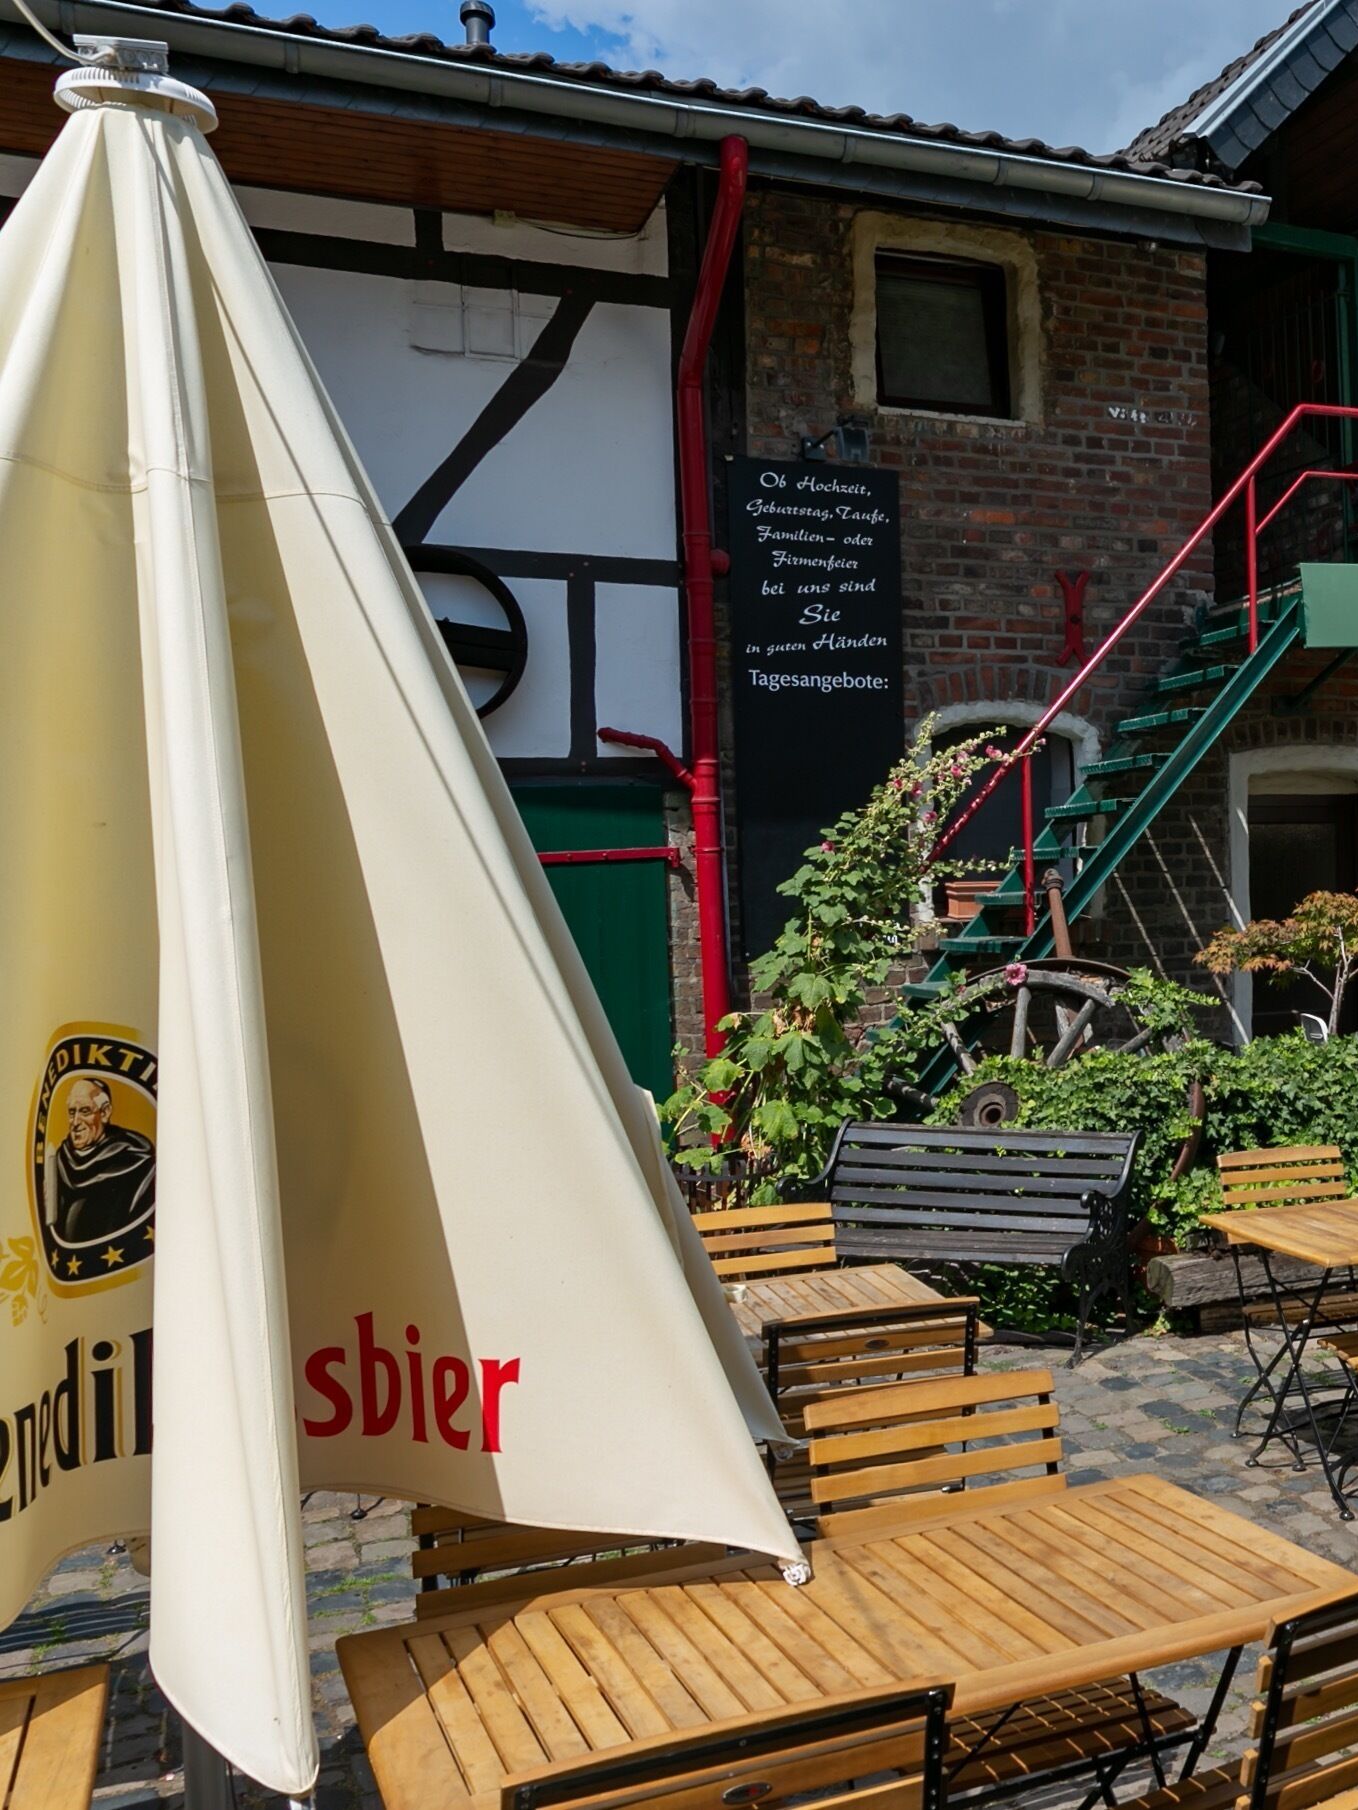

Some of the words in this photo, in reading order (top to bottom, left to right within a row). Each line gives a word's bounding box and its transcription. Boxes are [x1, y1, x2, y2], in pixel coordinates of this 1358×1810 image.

[760, 472, 787, 488] Ob
[797, 476, 872, 496] Hochzeit,
[746, 499, 833, 521] Geburtstag,
[836, 506, 890, 524] Taufe,
[756, 525, 835, 543] Familien-
[843, 534, 874, 546] oder
[772, 550, 858, 571] Firmenfeier
[762, 580, 785, 595] bei
[797, 581, 830, 594] uns
[839, 578, 876, 593] sind
[799, 604, 841, 625] Sie
[746, 643, 760, 653] in
[767, 641, 806, 656] guten
[813, 633, 887, 650] Händen
[748, 669, 889, 693] Tagesangebote:
[36, 1043, 158, 1164] BENEDIKTI
[295, 1311, 520, 1453] sbier
